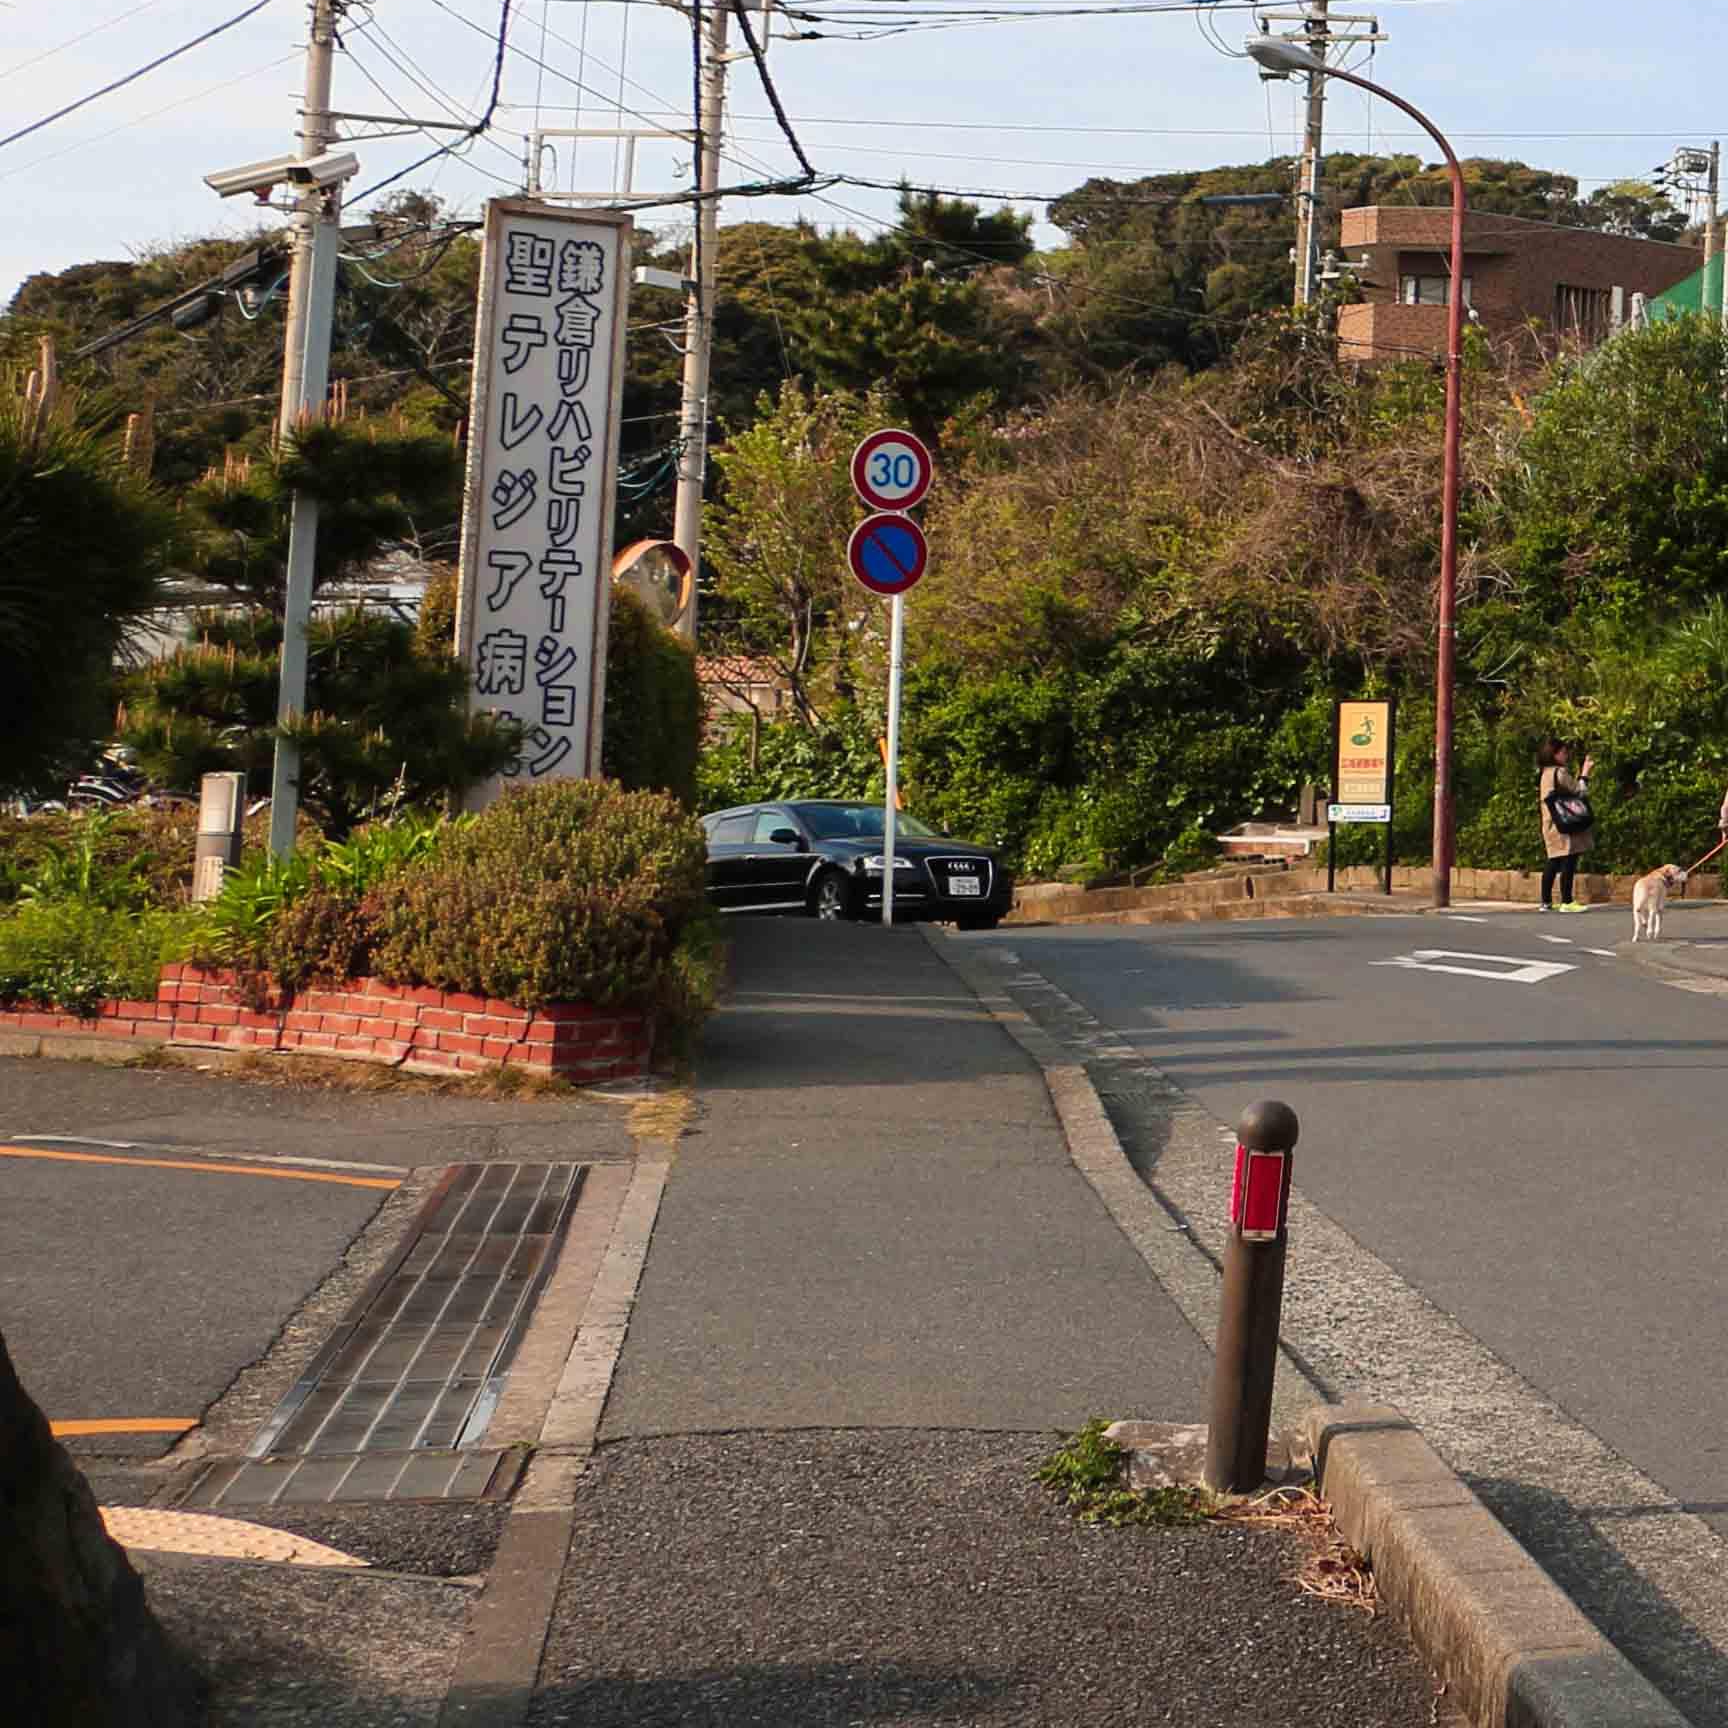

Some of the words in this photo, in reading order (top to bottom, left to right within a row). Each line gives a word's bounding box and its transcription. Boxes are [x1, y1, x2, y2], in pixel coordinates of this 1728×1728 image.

[530, 239, 605, 776] 鎌倉リハビリテーション
[871, 453, 914, 488] 30
